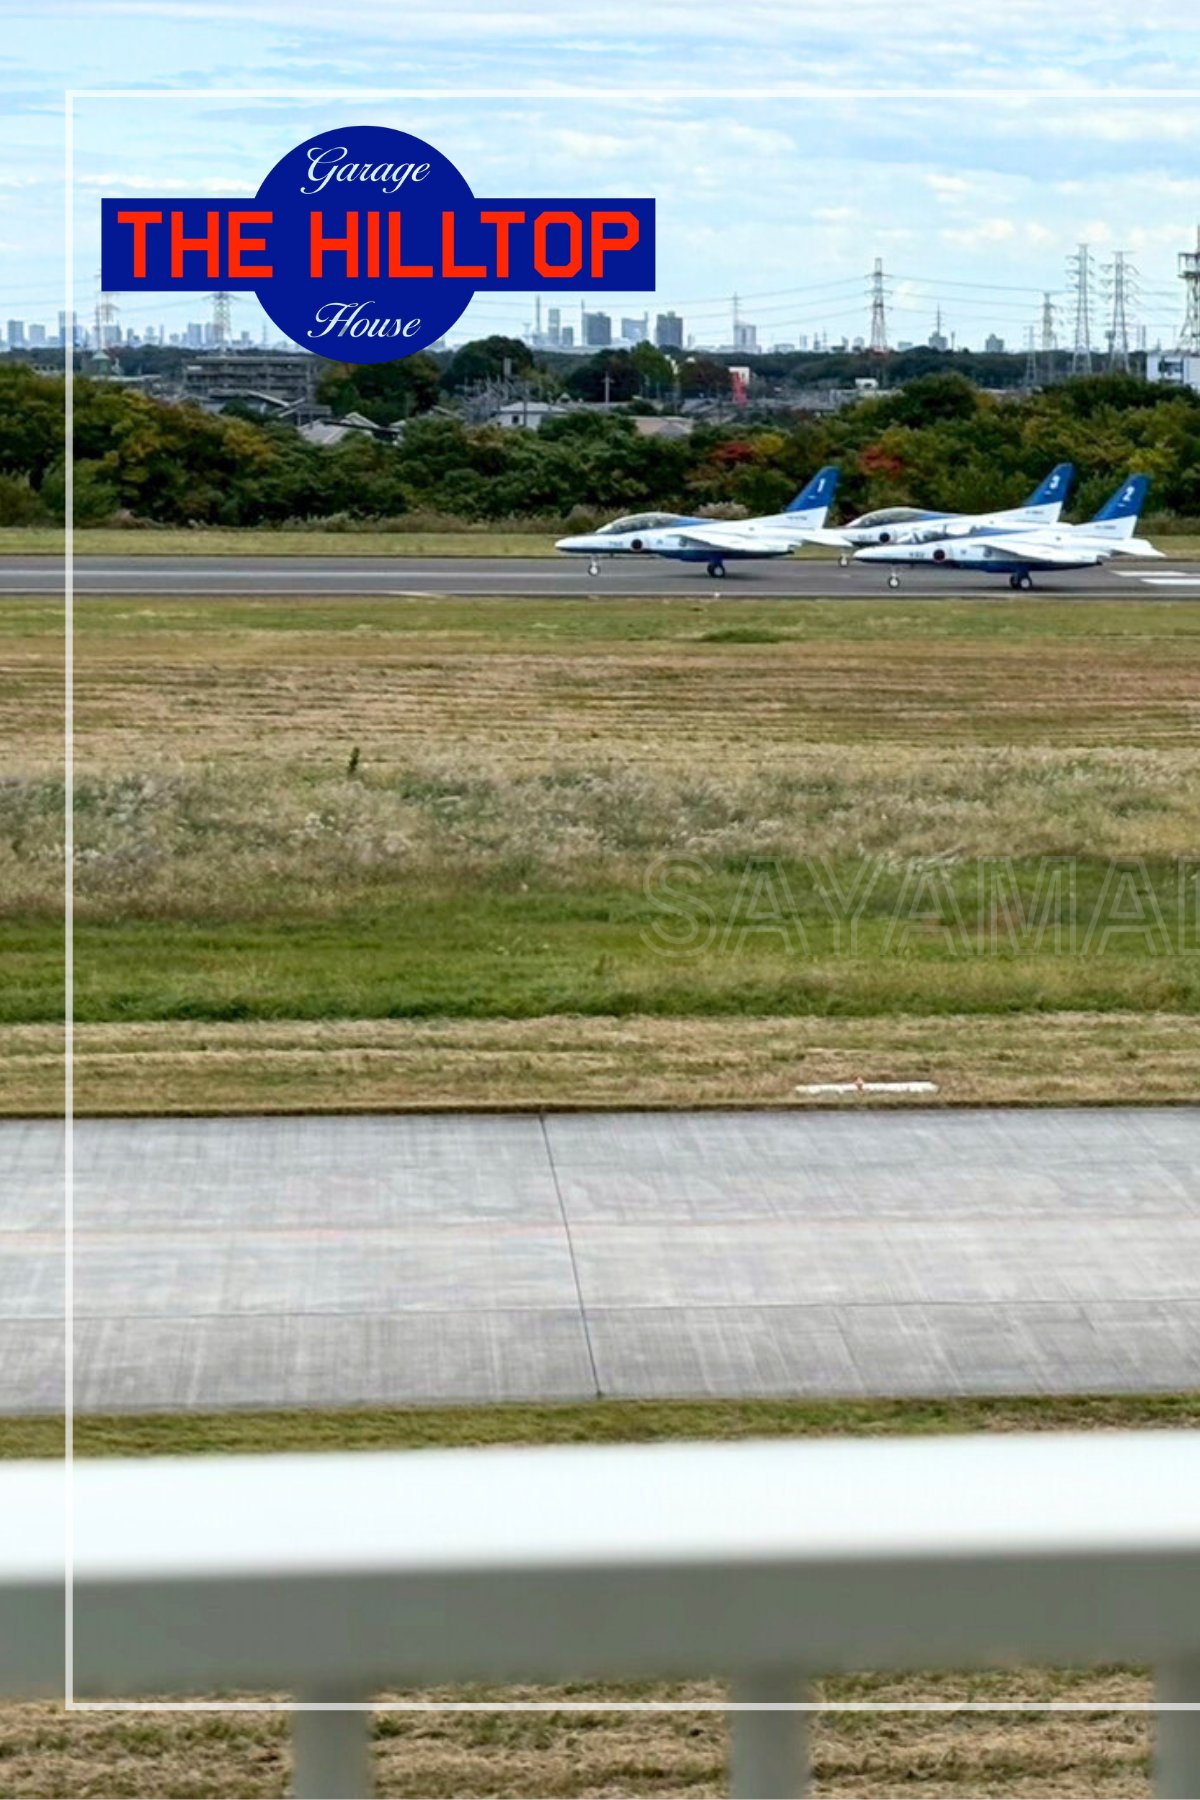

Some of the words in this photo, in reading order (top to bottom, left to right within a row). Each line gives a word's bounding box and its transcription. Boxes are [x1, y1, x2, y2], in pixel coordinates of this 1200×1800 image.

[817, 478, 825, 493] 1
[1050, 475, 1060, 489] 3
[1122, 486, 1134, 501] 2
